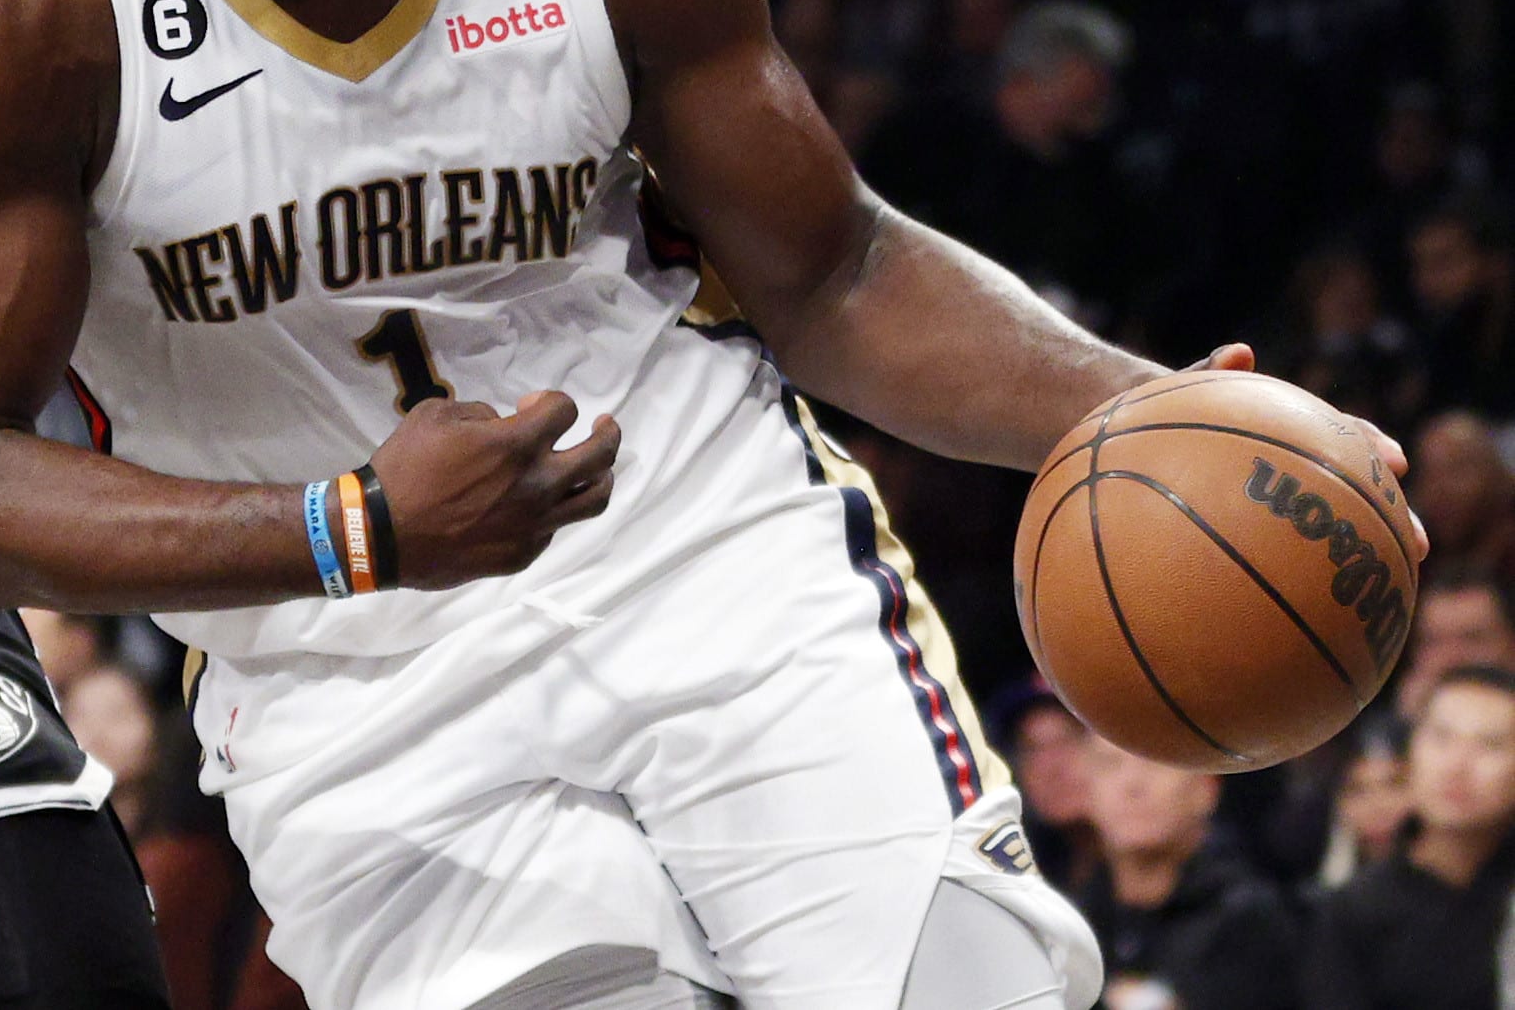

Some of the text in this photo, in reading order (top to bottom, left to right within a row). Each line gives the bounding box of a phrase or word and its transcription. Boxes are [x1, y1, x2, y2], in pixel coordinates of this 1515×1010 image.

[445, 1, 565, 53] ibotta
[132, 198, 302, 324] NEW
[353, 307, 455, 416] 1
